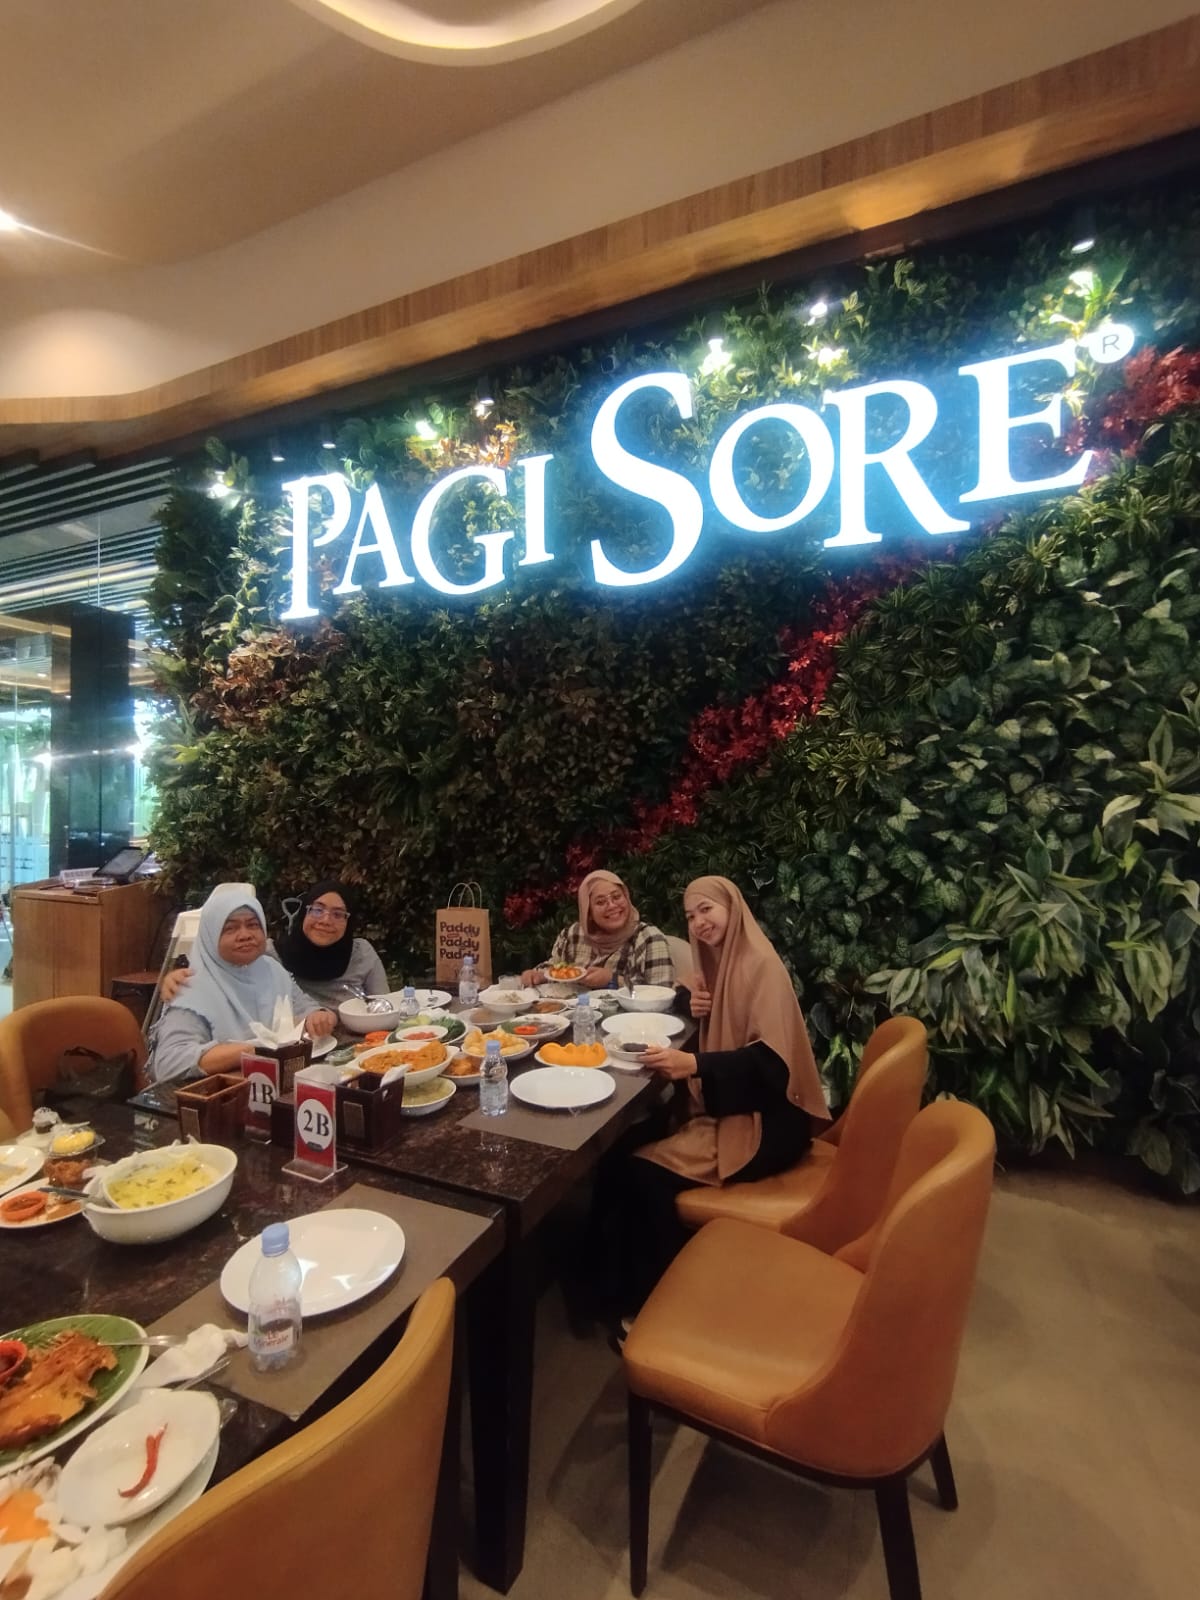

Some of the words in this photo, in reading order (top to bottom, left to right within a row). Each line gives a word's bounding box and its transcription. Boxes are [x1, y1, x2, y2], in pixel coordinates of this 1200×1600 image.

[281, 453, 555, 621] PAGI
[590, 342, 1096, 588] SORE
[440, 921, 480, 937] Paddy
[440, 935, 480, 951] Paddy
[251, 1082, 273, 1105] 1B
[303, 1109, 330, 1137] 2B
